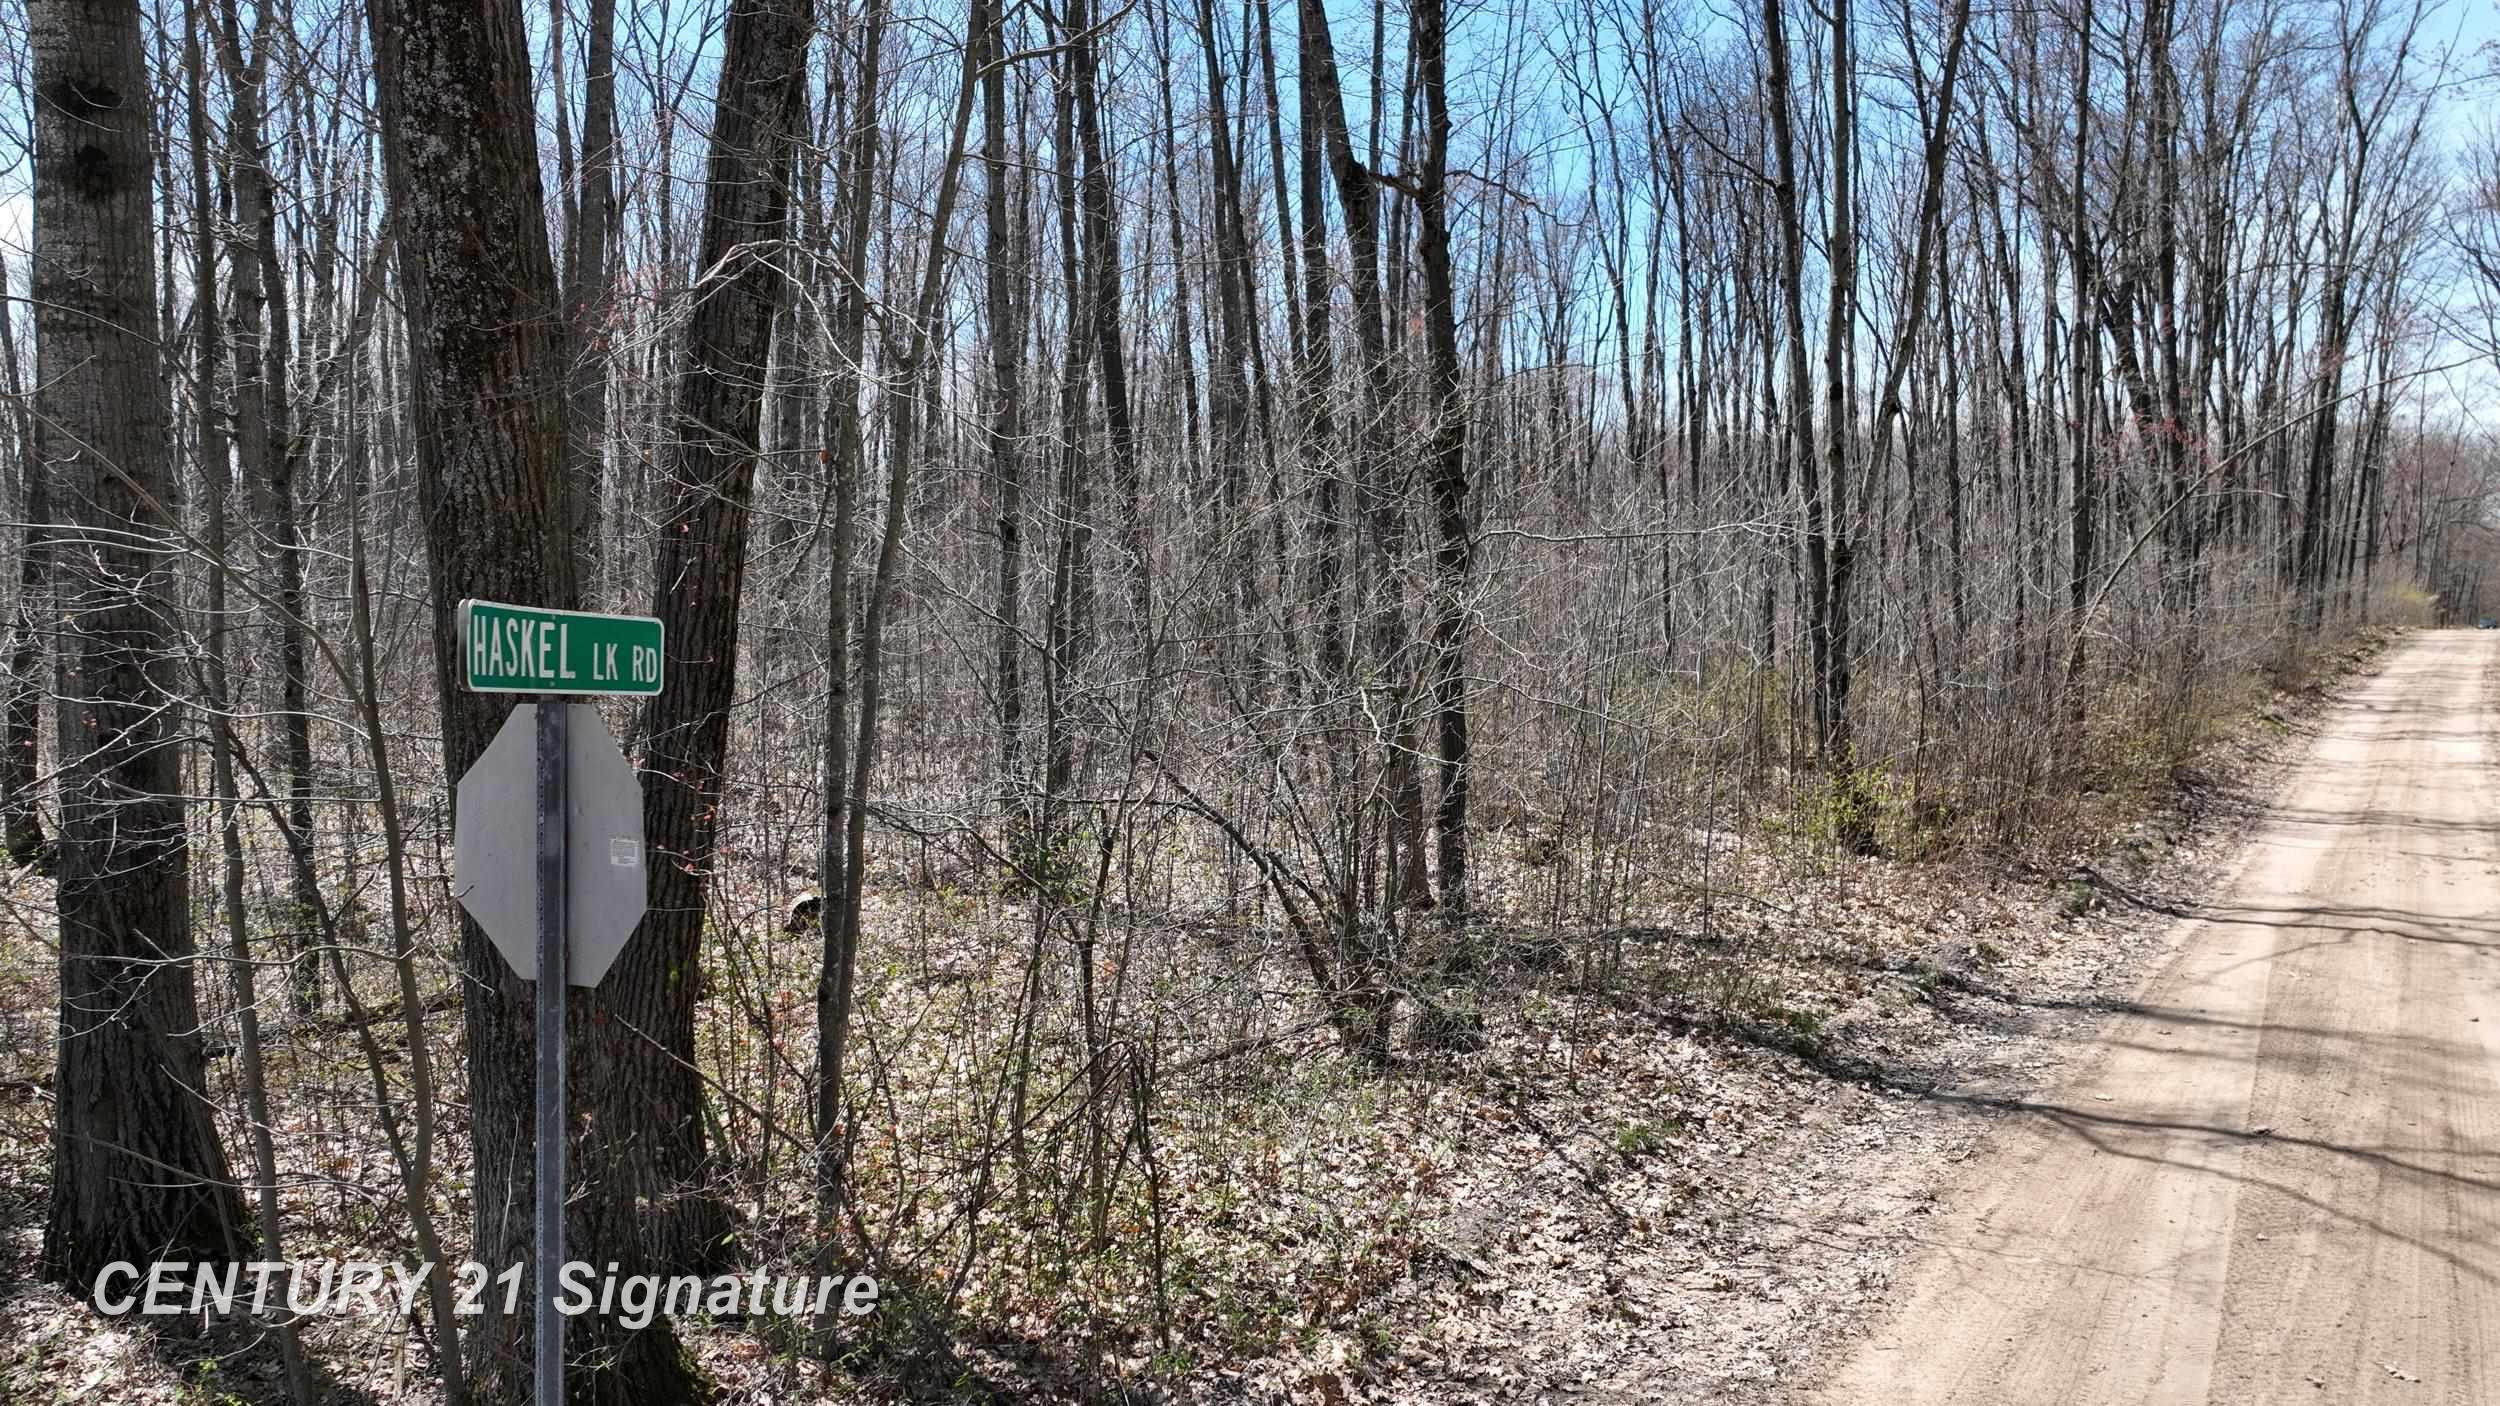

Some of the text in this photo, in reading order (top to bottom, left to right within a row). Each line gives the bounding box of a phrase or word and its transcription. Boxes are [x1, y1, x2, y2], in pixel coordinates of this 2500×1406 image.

[473, 614, 658, 684] HASKEL LK RD
